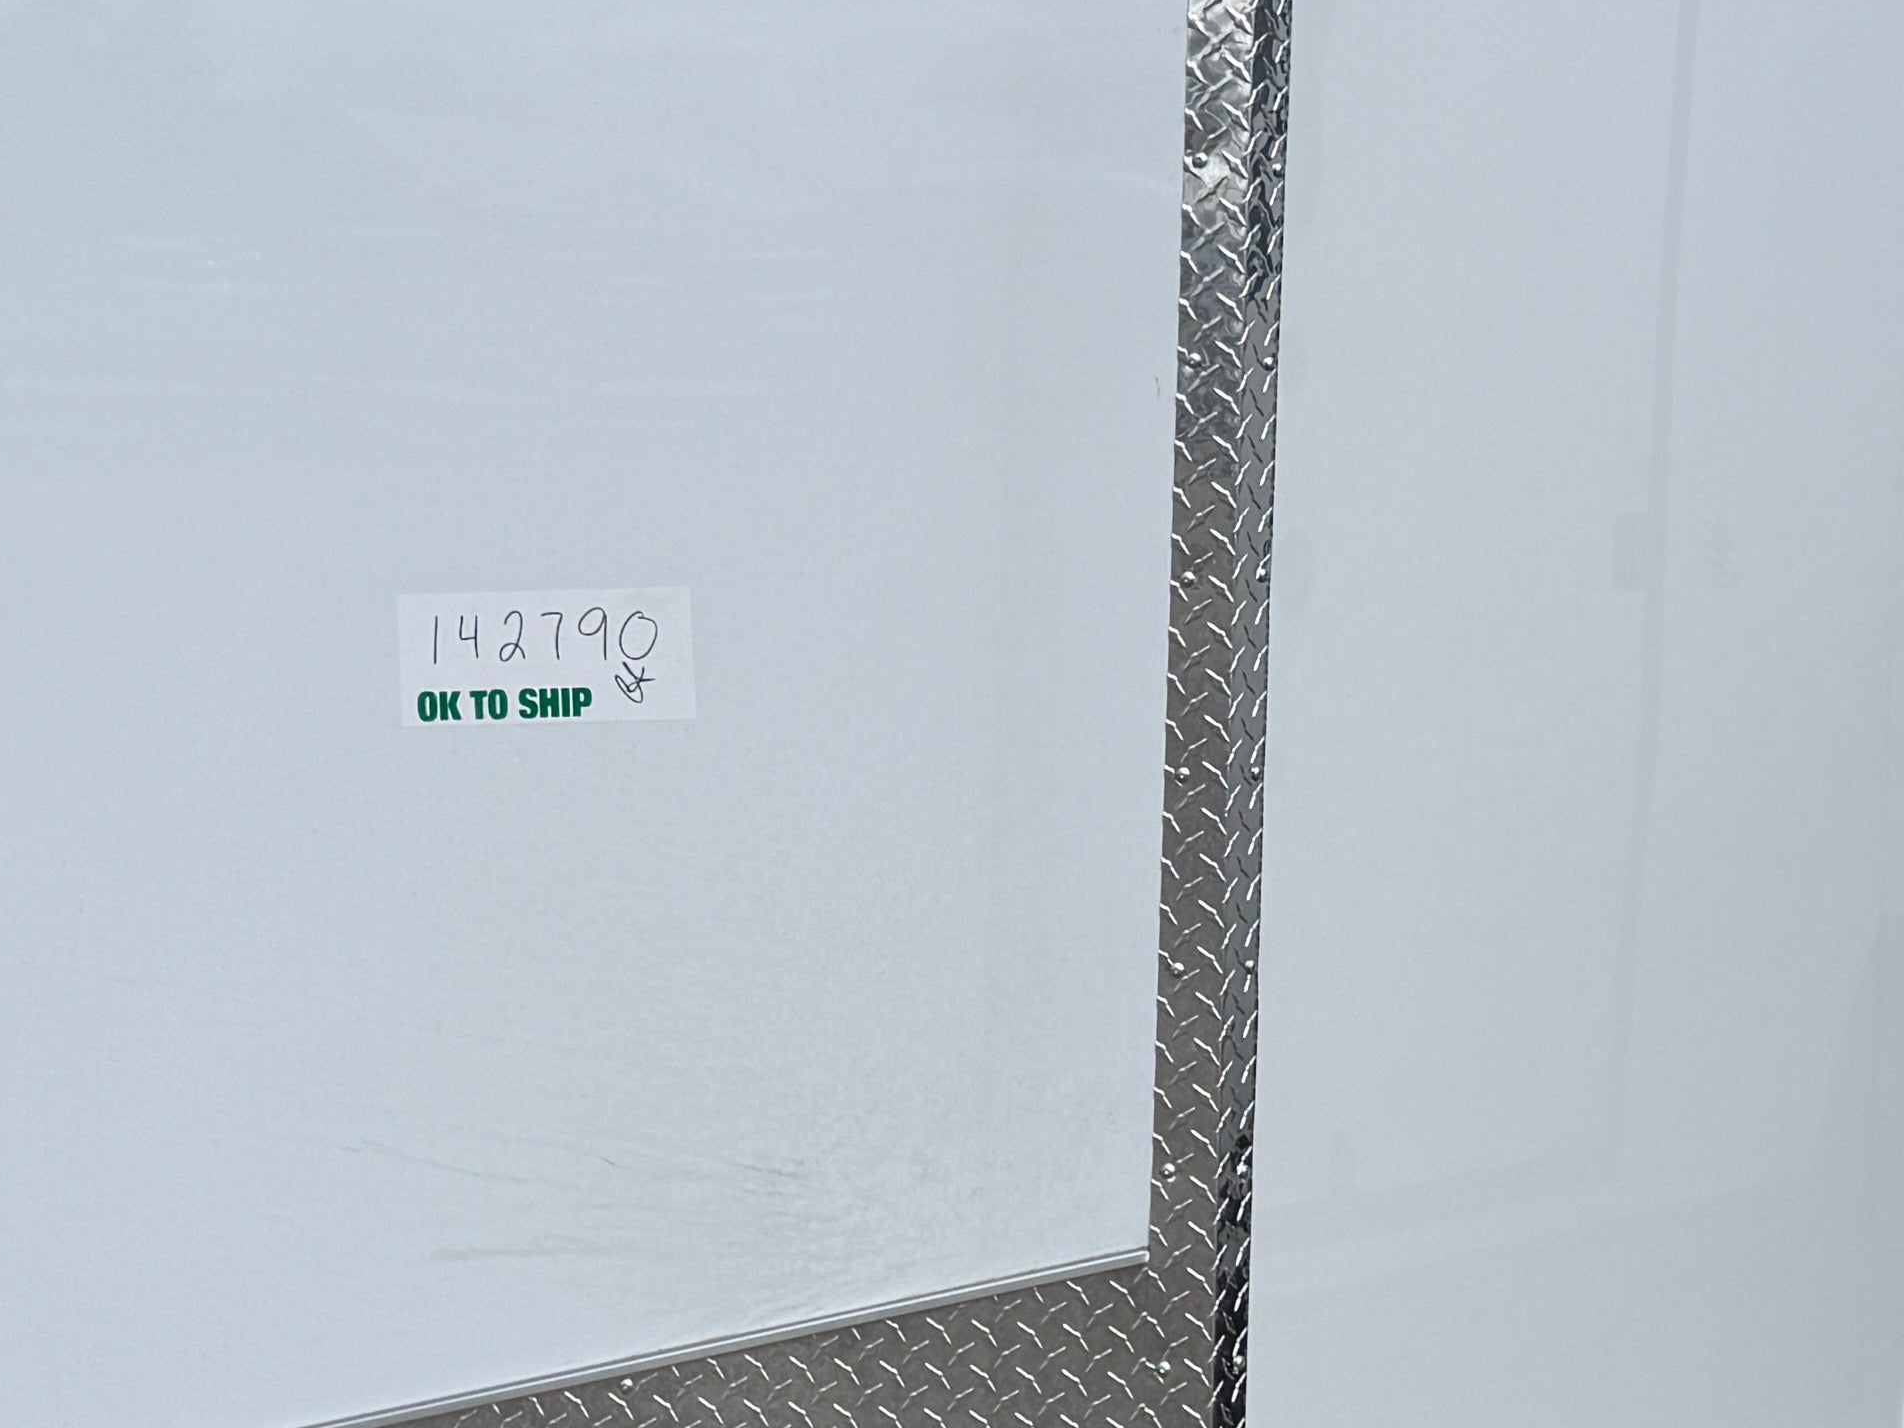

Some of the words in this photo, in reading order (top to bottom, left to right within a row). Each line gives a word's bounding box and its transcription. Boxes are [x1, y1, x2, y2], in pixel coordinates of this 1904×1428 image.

[432, 606, 659, 664] 142790
[417, 691, 462, 722] OK
[469, 690, 508, 720] TO
[518, 687, 593, 719] SHIP
